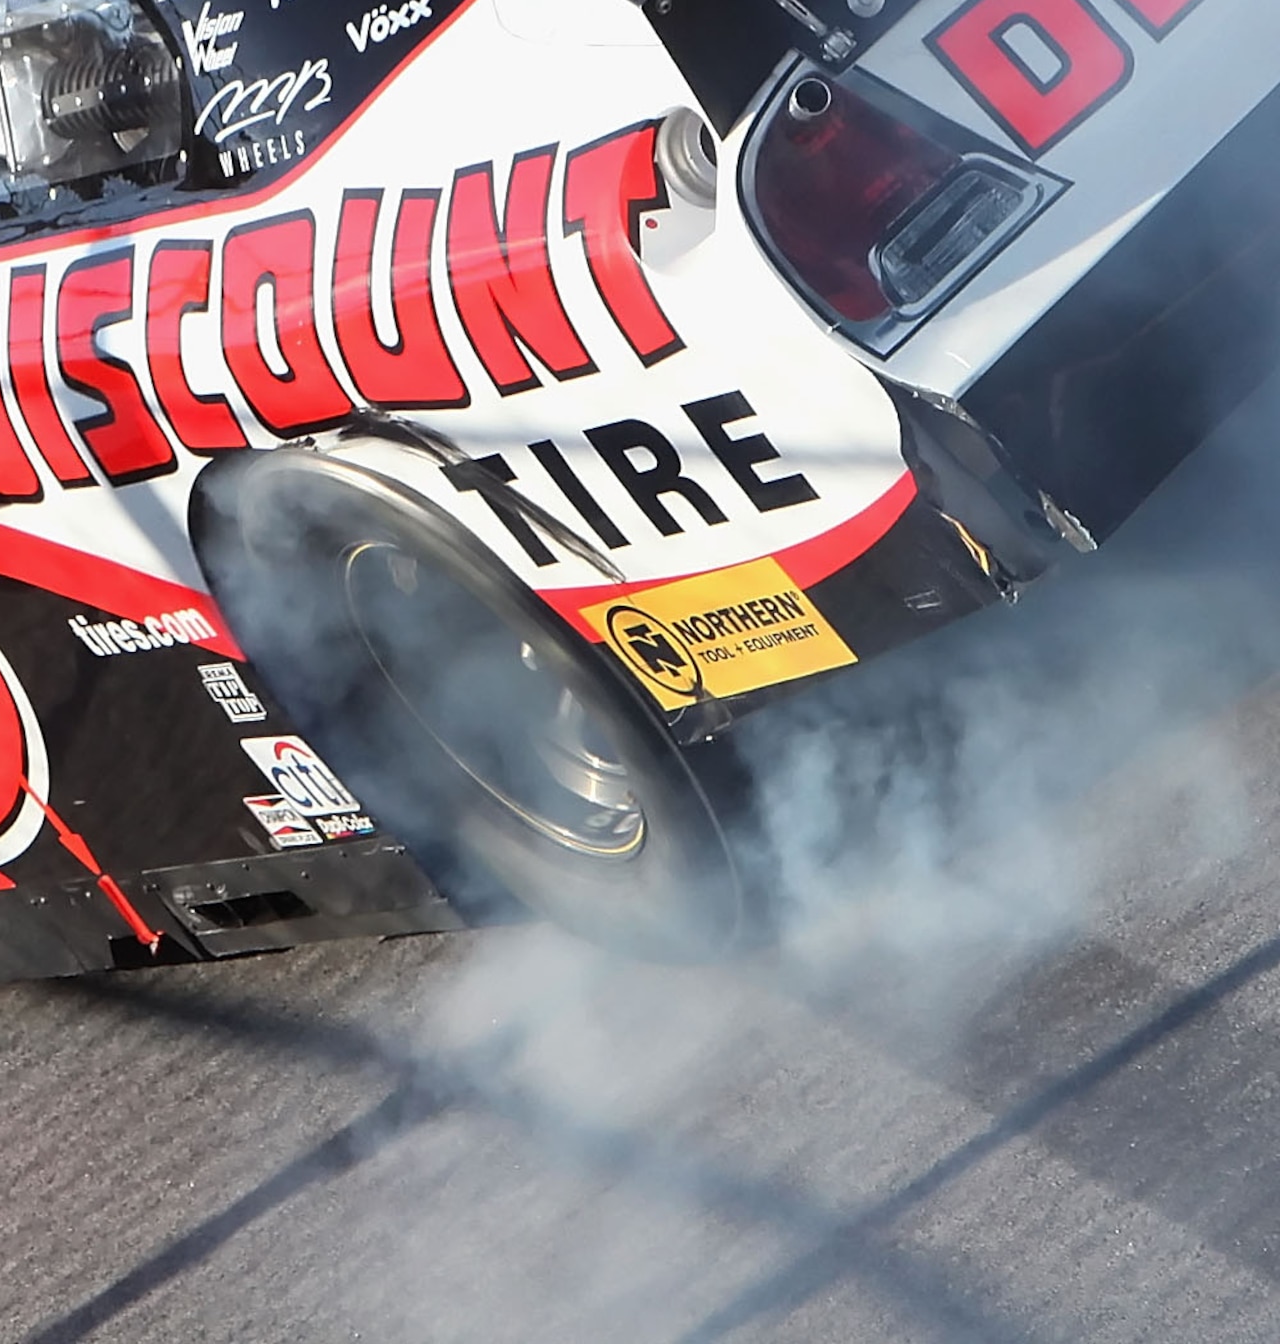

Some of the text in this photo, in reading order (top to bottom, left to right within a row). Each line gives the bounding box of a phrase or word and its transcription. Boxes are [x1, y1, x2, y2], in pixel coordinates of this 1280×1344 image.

[182, 1, 245, 70] Vision
[219, 129, 306, 178] WHEELS
[439, 389, 821, 568] TIRE
[69, 608, 218, 657] tires.com
[671, 591, 806, 646] NORTHERN
[697, 646, 737, 664] TOOL
[742, 622, 820, 654] EQUIPMENT
[206, 680, 240, 698] TIP
[225, 696, 260, 714] TOP
[271, 754, 351, 809] citi
